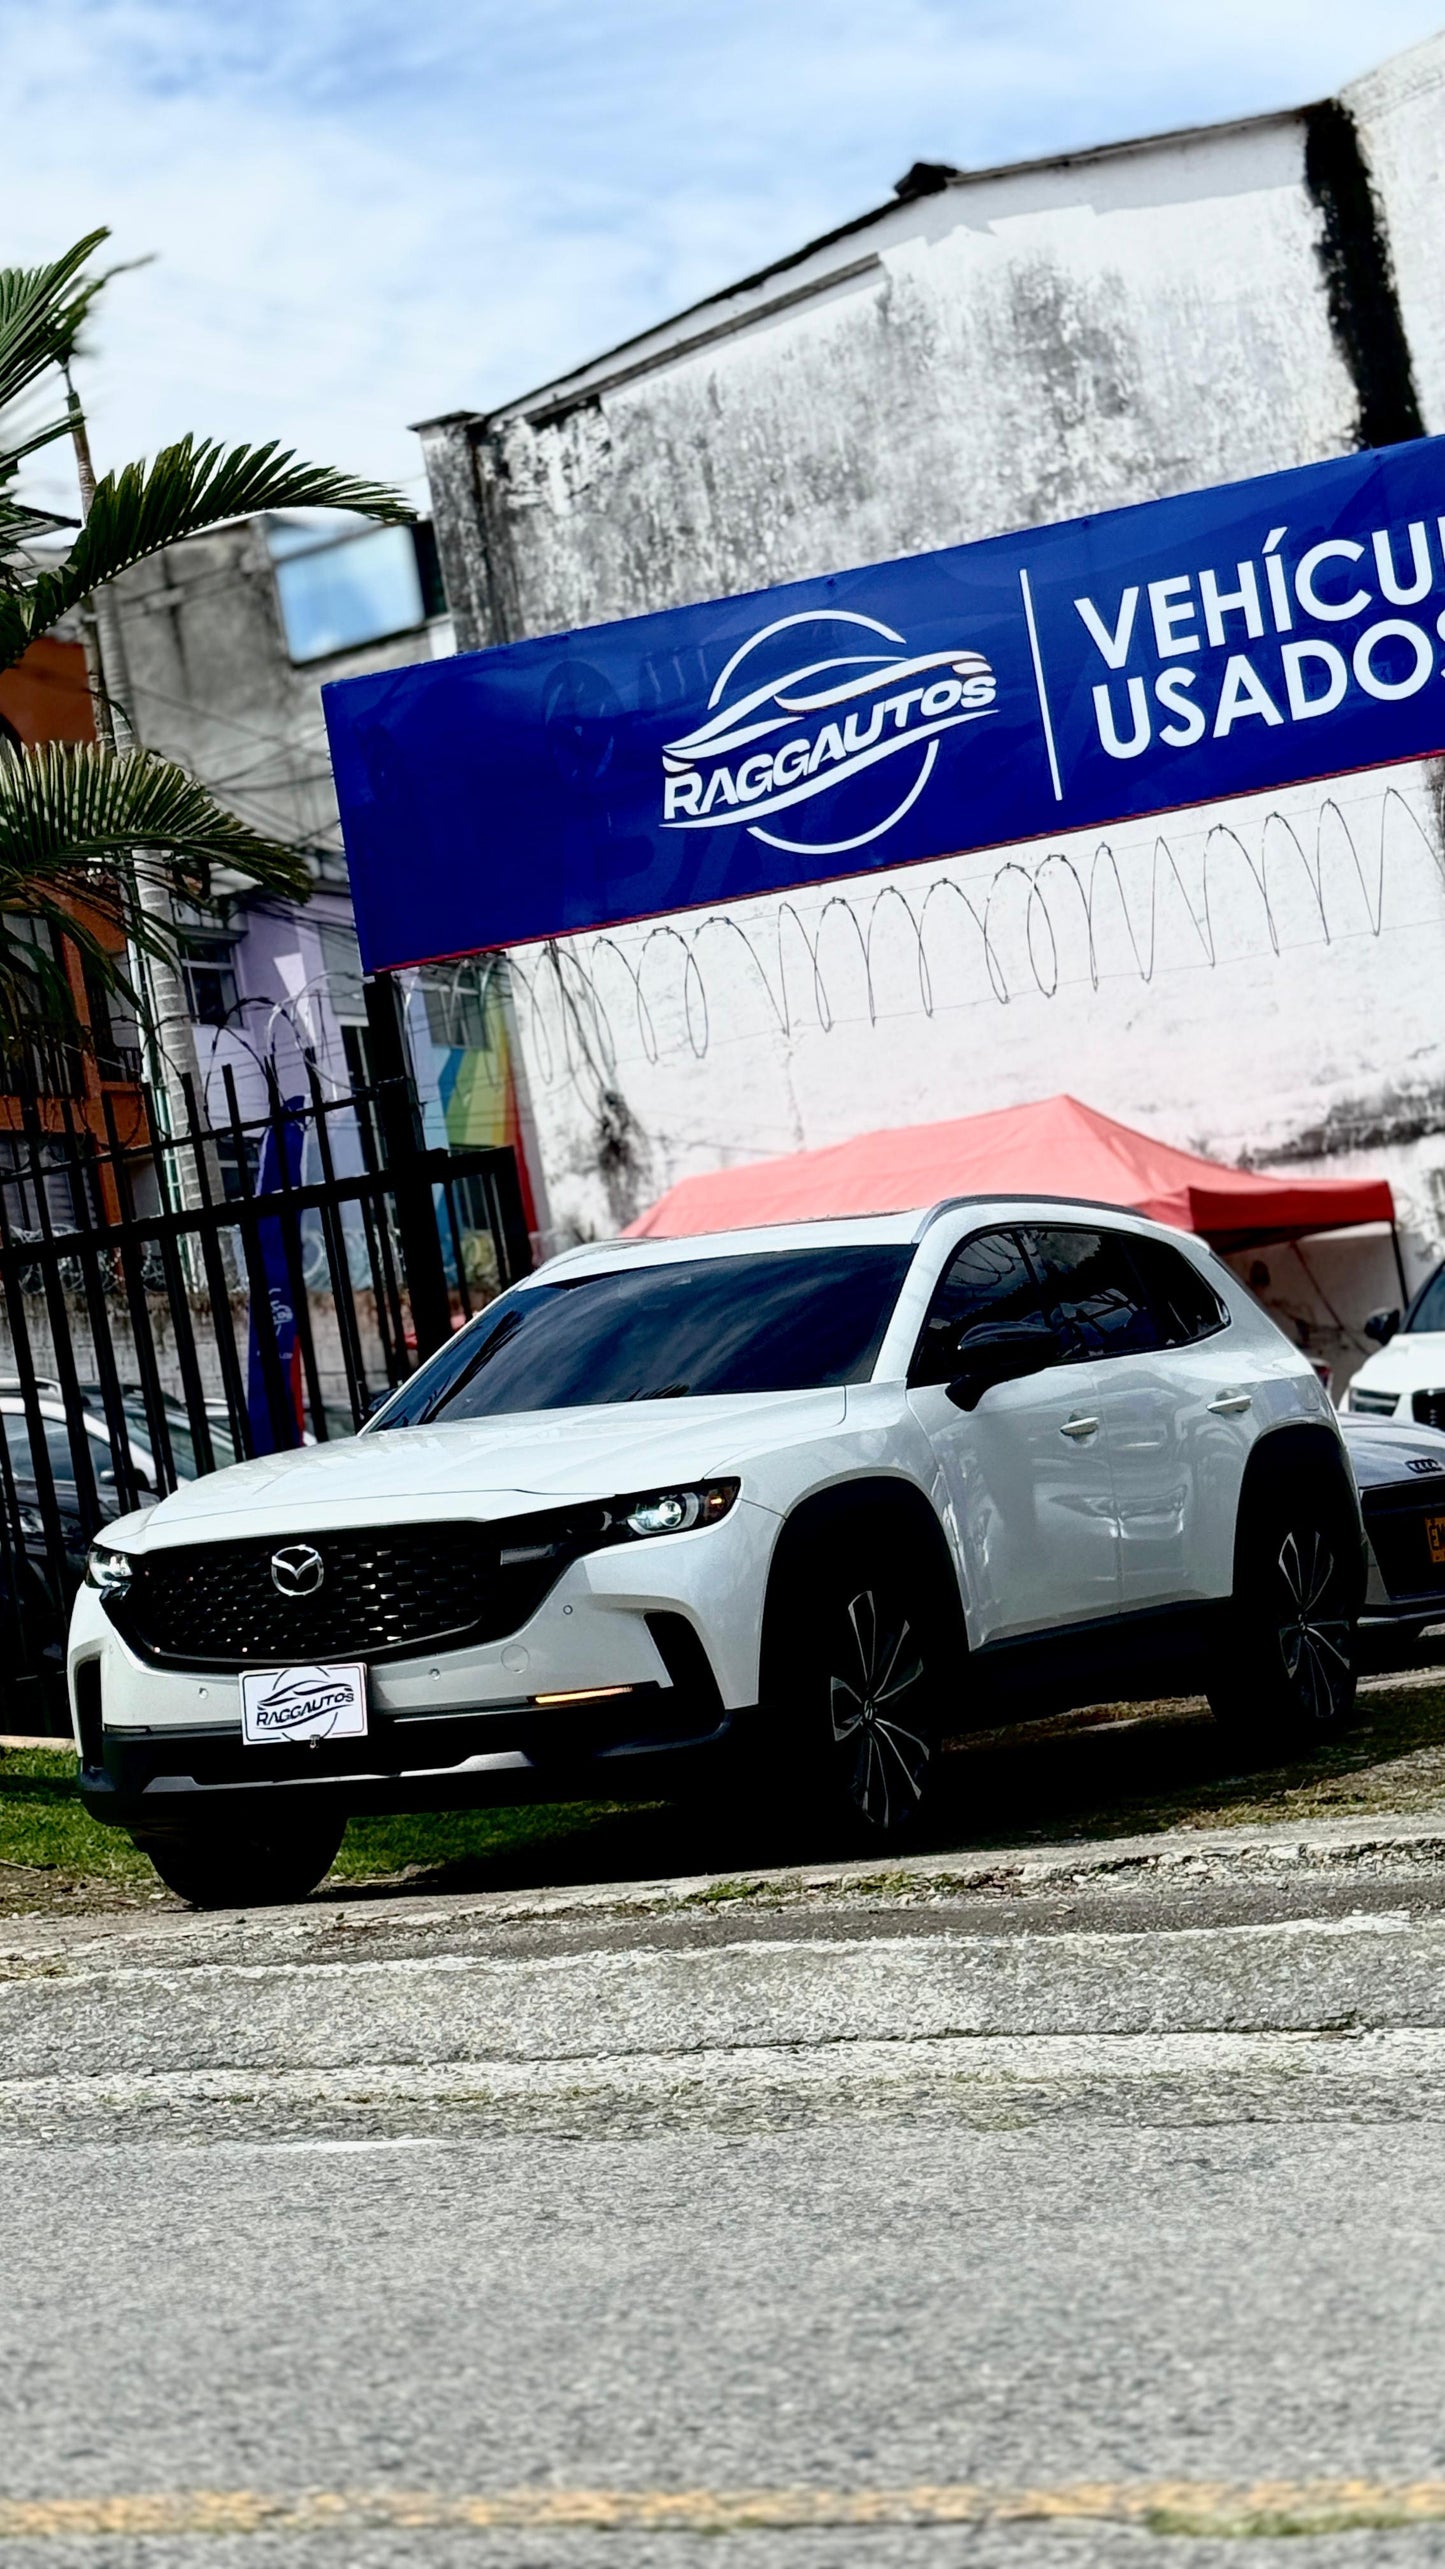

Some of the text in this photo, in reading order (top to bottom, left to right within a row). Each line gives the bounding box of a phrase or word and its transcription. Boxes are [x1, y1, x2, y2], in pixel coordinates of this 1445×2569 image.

[1074, 516, 1445, 669] VEHÍCU
[663, 673, 997, 820] RAGGAUTOS
[1092, 609, 1445, 759] USADO
[256, 1692, 354, 1727] RAGGAUTOS
